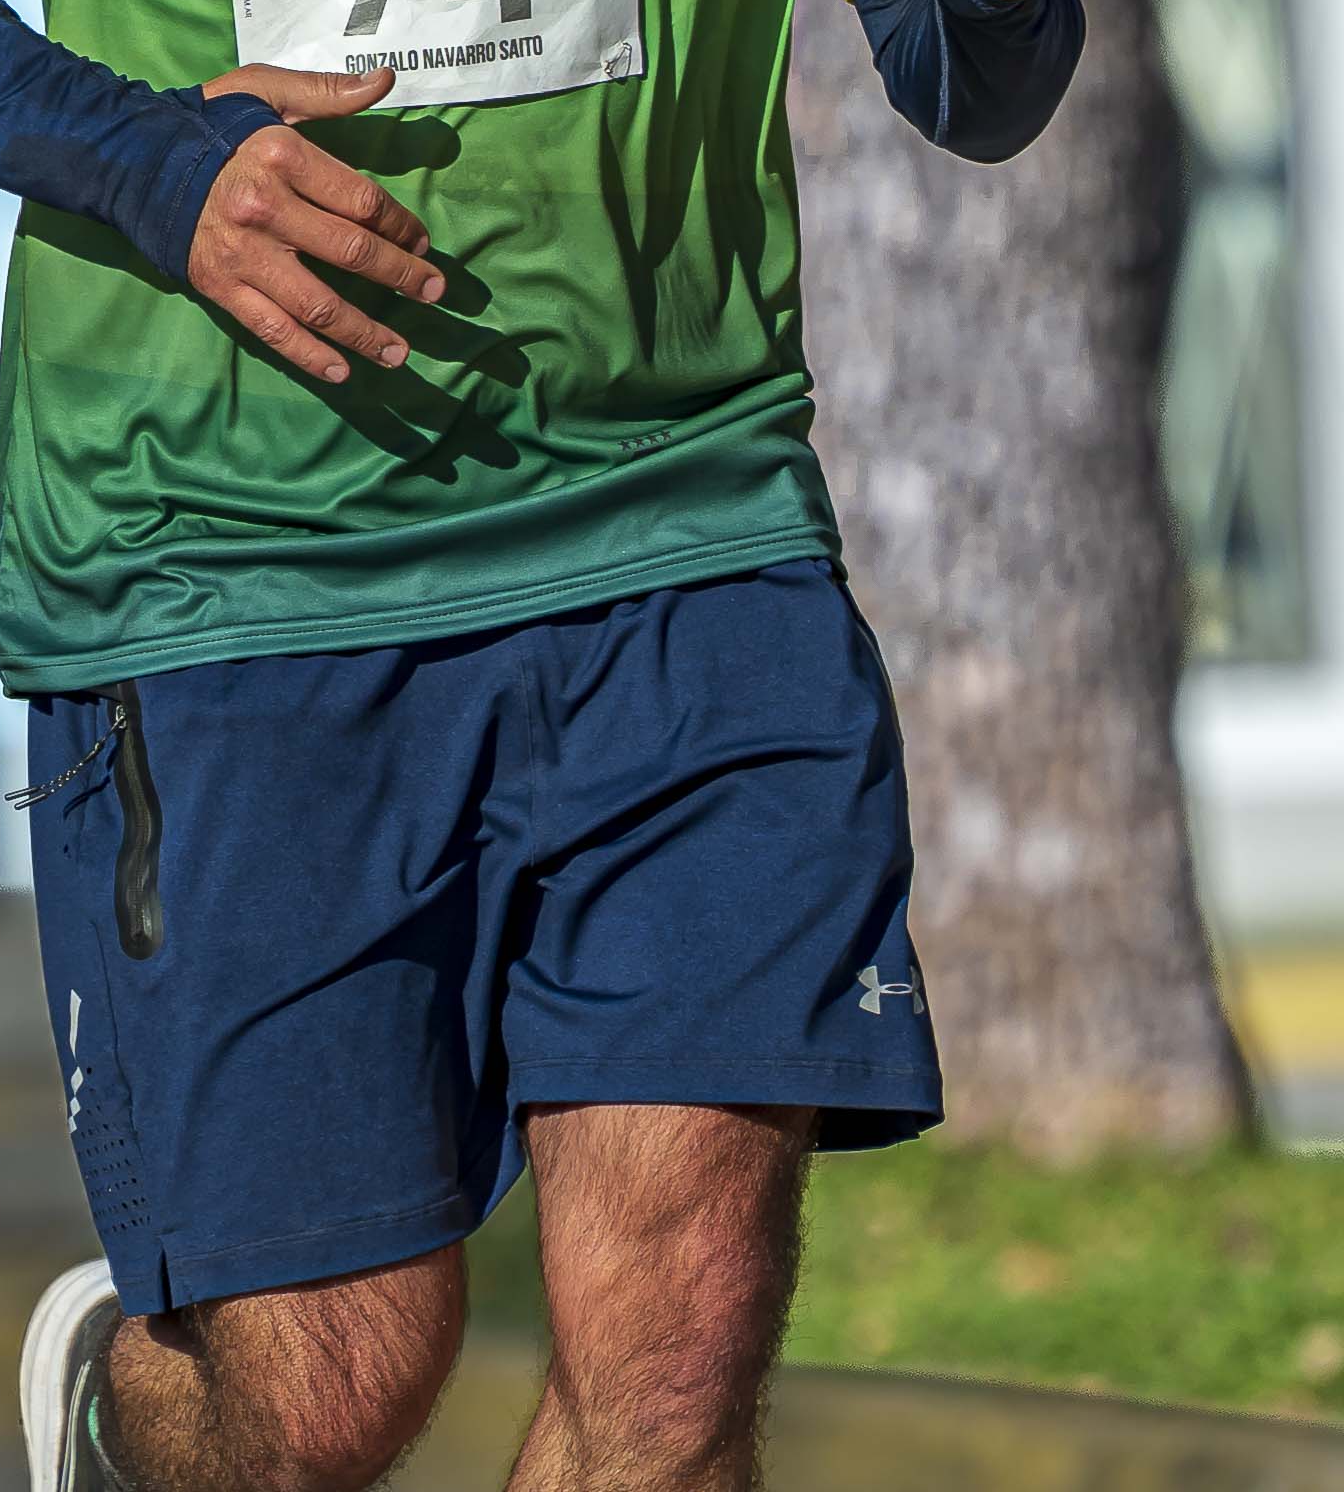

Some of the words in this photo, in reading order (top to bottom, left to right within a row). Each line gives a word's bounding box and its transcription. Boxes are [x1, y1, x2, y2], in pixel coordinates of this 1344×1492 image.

[345, 49, 419, 75] GONZALO
[422, 41, 496, 70] NAVARRO
[499, 34, 544, 61] SAITO
